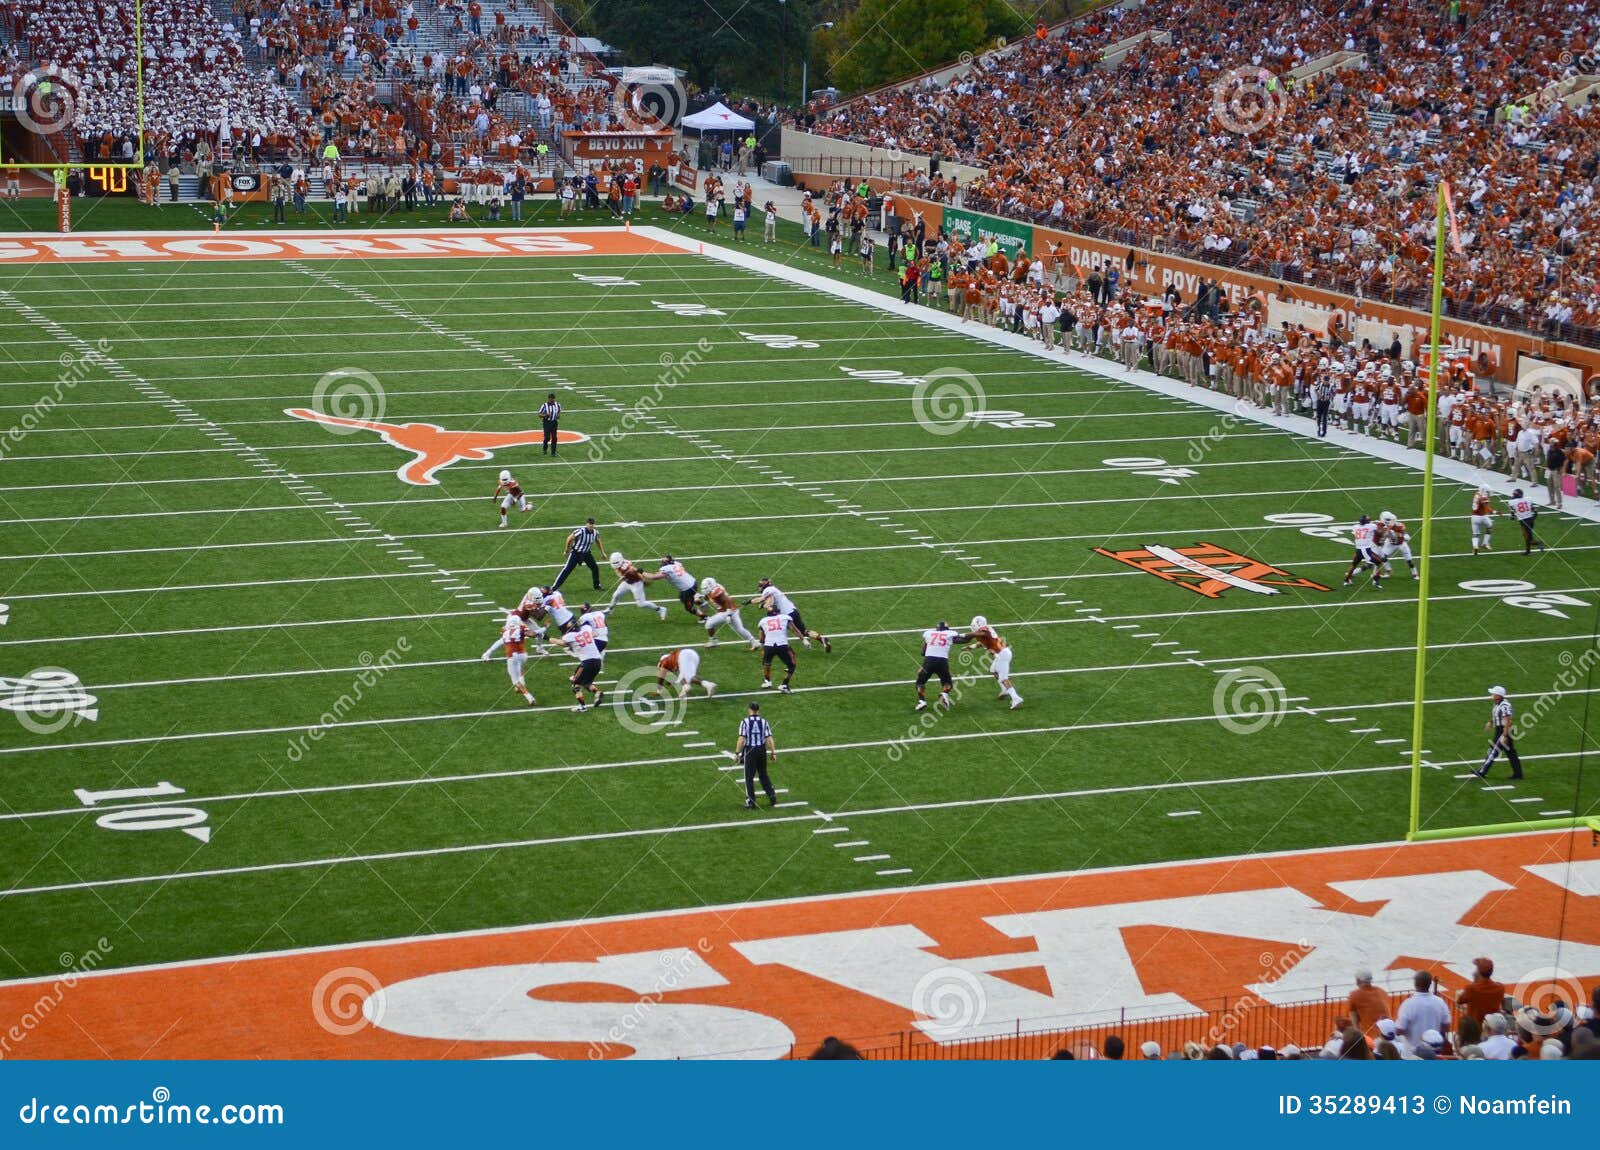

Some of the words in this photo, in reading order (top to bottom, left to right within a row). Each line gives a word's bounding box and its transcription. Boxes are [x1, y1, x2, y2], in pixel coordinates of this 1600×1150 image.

[588, 138, 619, 150] BEVO
[622, 137, 645, 150] XIV
[90, 167, 127, 192] 40
[62, 197, 71, 232] TEXAS
[0, 236, 594, 259] HORNS
[1145, 264, 1156, 285] K
[767, 618, 782, 632] 51
[575, 631, 593, 648] 58
[930, 633, 947, 647] 75
[73, 781, 209, 830] 10
